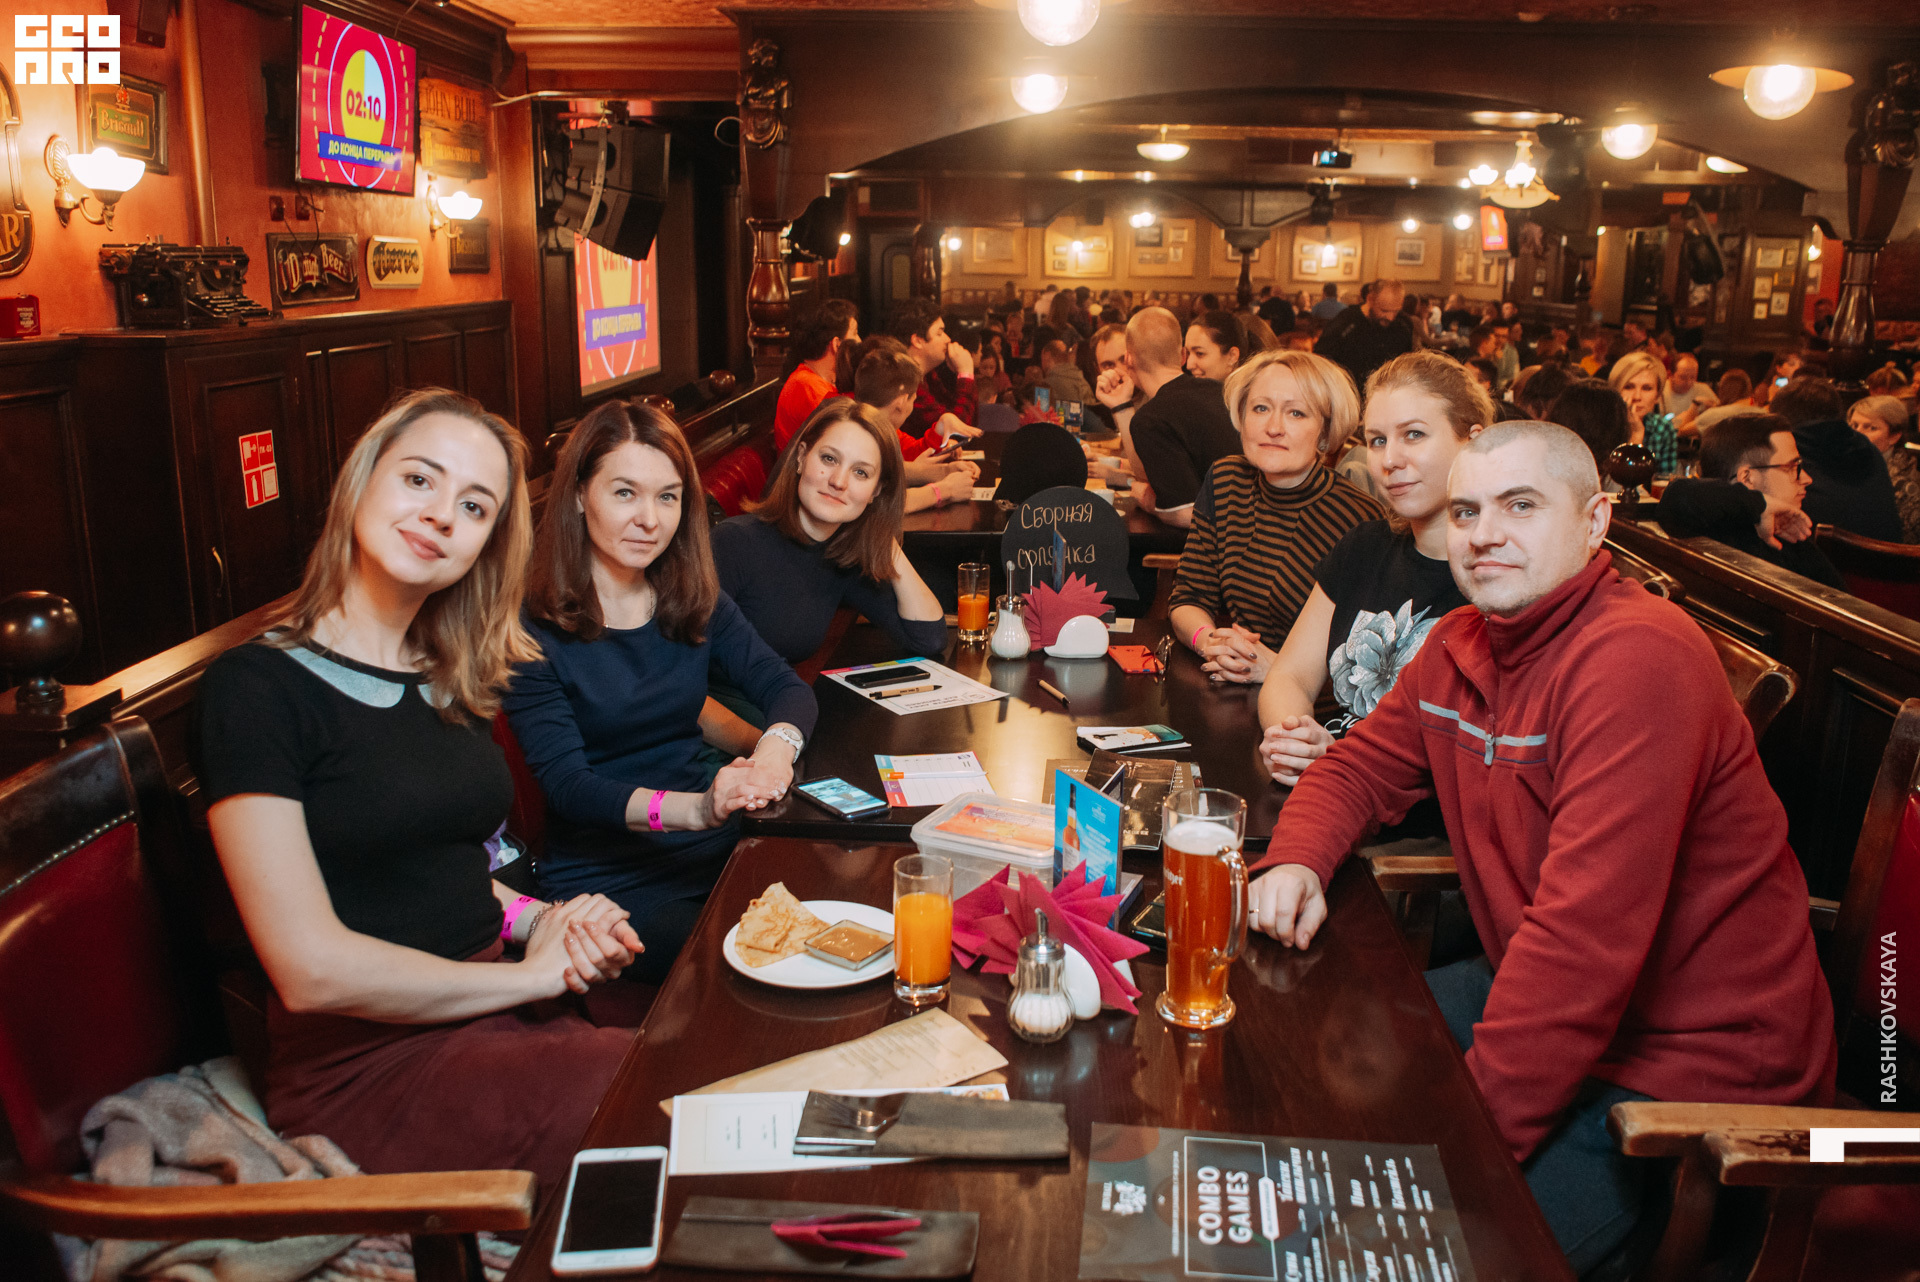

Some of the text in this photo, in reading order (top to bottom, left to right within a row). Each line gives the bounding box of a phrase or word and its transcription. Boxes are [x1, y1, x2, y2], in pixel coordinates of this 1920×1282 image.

[346, 88, 382, 122] 02:10
[328, 139, 340, 155] ДО
[340, 140, 364, 160] КОНЦА
[1021, 503, 1093, 531] Сборная
[1198, 1165, 1223, 1245] COMBO
[1226, 1170, 1253, 1244] GAMES
